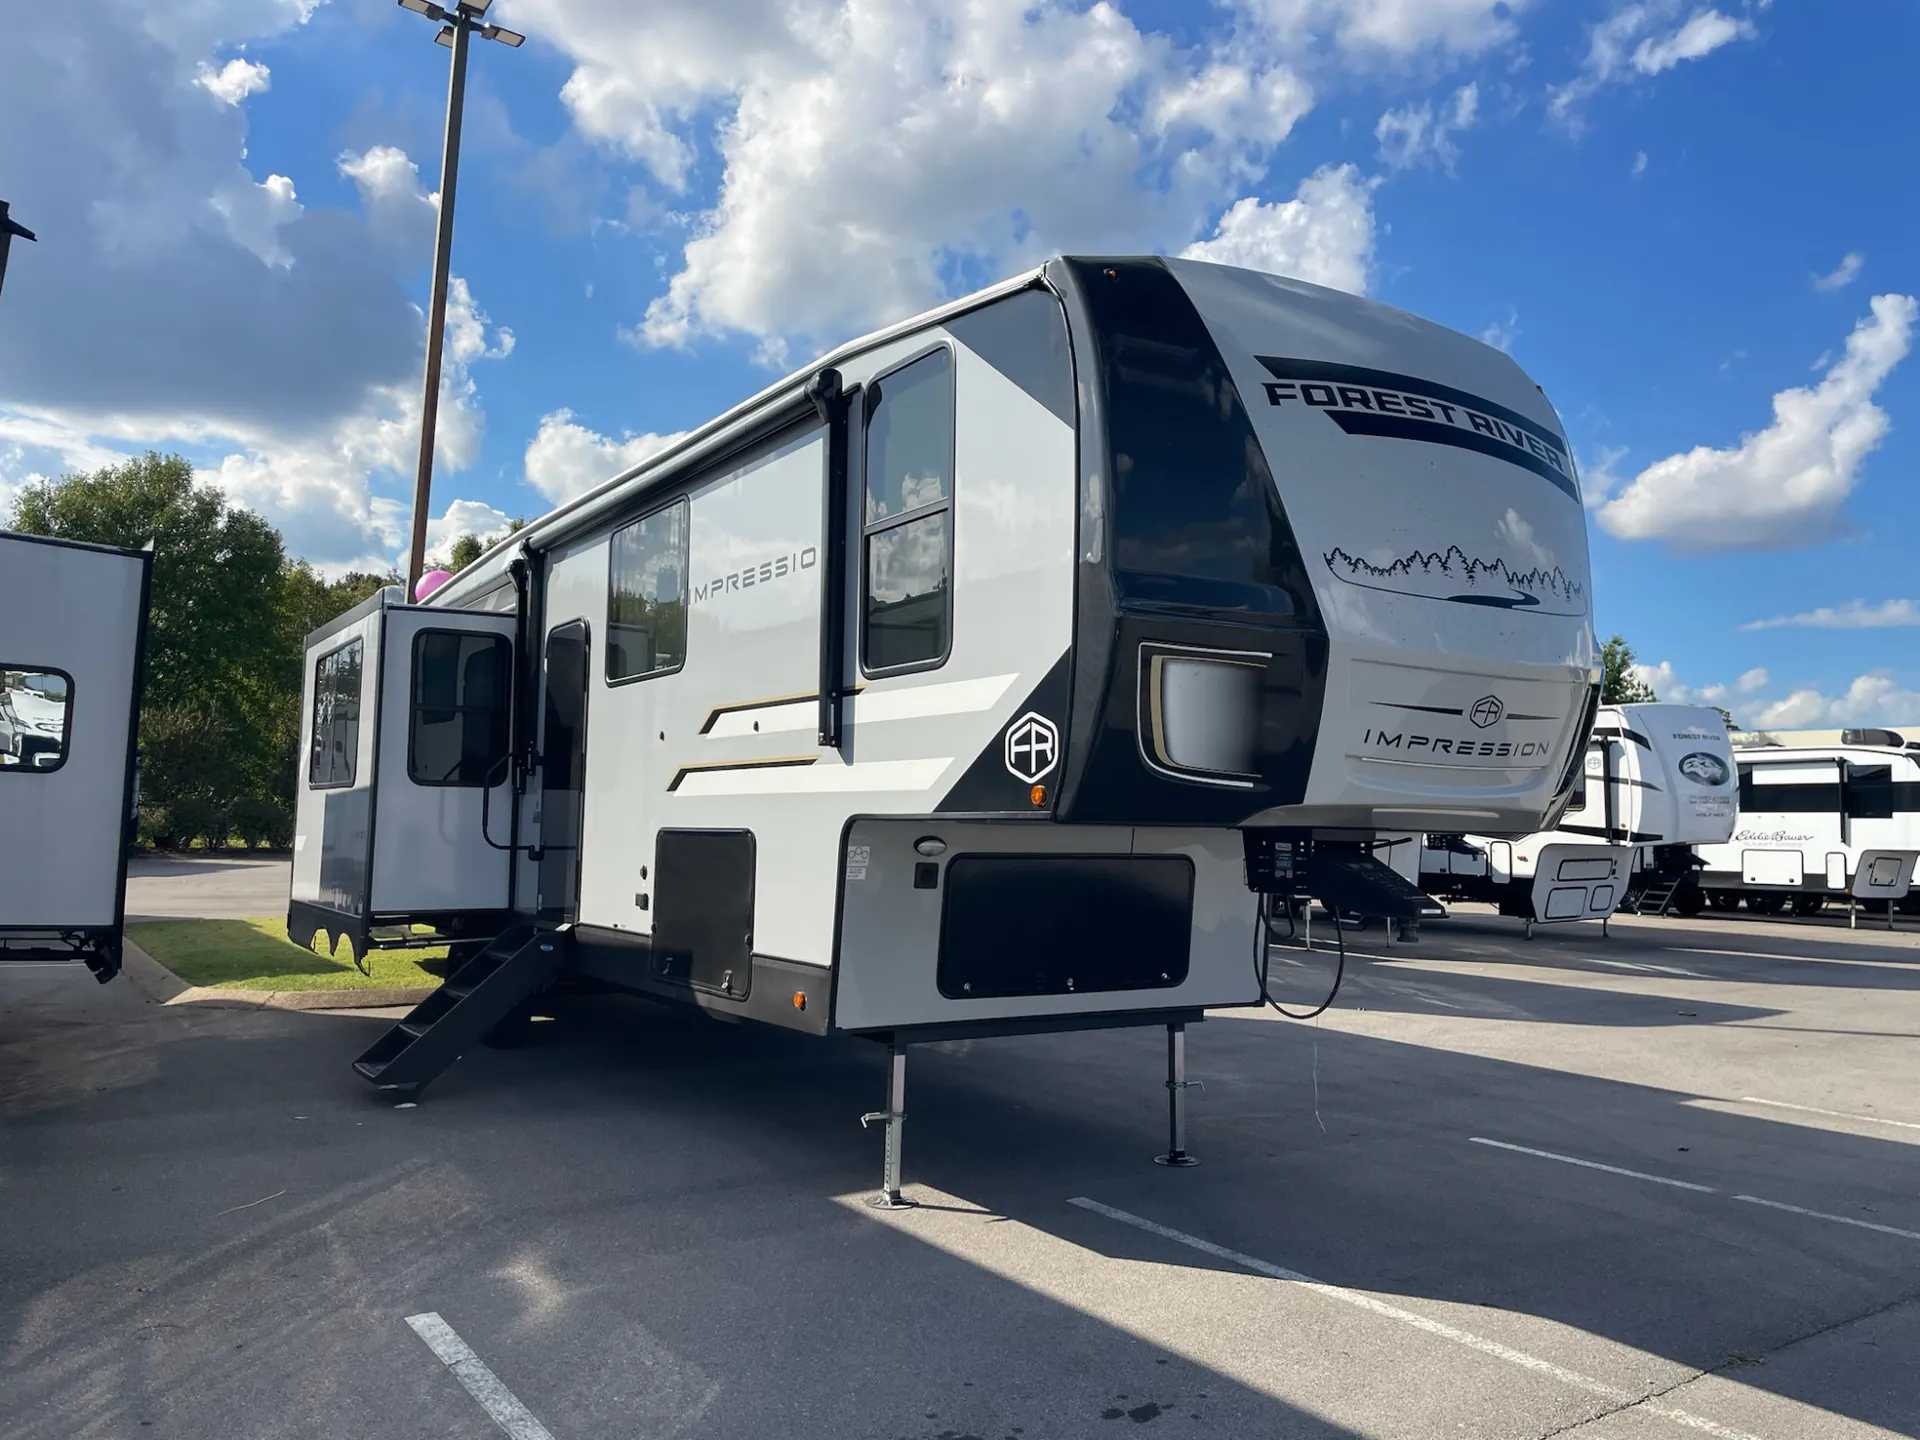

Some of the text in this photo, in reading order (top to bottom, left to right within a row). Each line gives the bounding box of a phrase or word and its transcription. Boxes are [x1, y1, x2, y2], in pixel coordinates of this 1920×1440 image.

[1260, 382, 1565, 473] FOREST RIVER
[687, 546, 817, 606] IMPRESSIO
[1363, 729, 1550, 758] IMPRESSION
